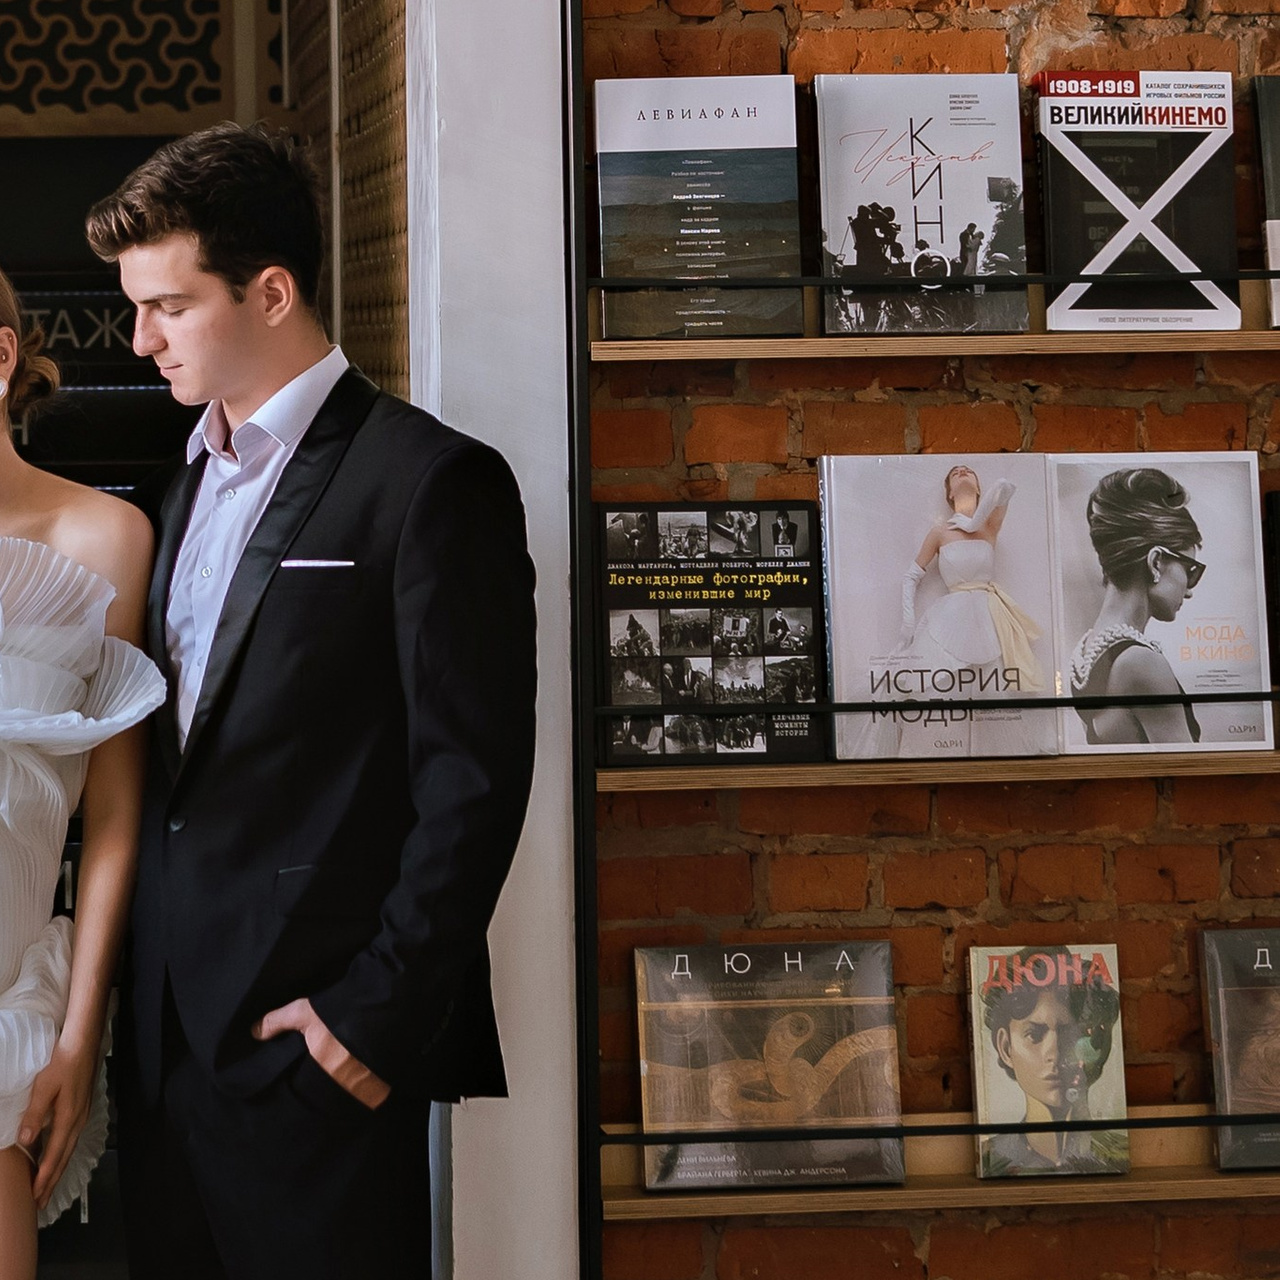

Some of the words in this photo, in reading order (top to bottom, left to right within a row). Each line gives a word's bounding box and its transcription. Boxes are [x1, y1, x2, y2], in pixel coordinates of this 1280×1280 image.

[1049, 79, 1136, 94] 1908-1919
[637, 106, 758, 121] ЛЕВИАФАН
[608, 573, 704, 586] Легендарные
[713, 571, 808, 586] фотографии,
[649, 589, 735, 600] изменившие
[744, 588, 771, 600] мир
[1185, 625, 1246, 643] МОДА
[1180, 646, 1192, 660] В
[1197, 645, 1255, 660] КИНО
[870, 667, 1020, 694] ИСТОРИЯ
[1228, 725, 1257, 734] ОДРИ
[933, 739, 963, 749] ОДРИ
[671, 950, 857, 980] ДЮНА
[981, 952, 1115, 995] ДЮНА
